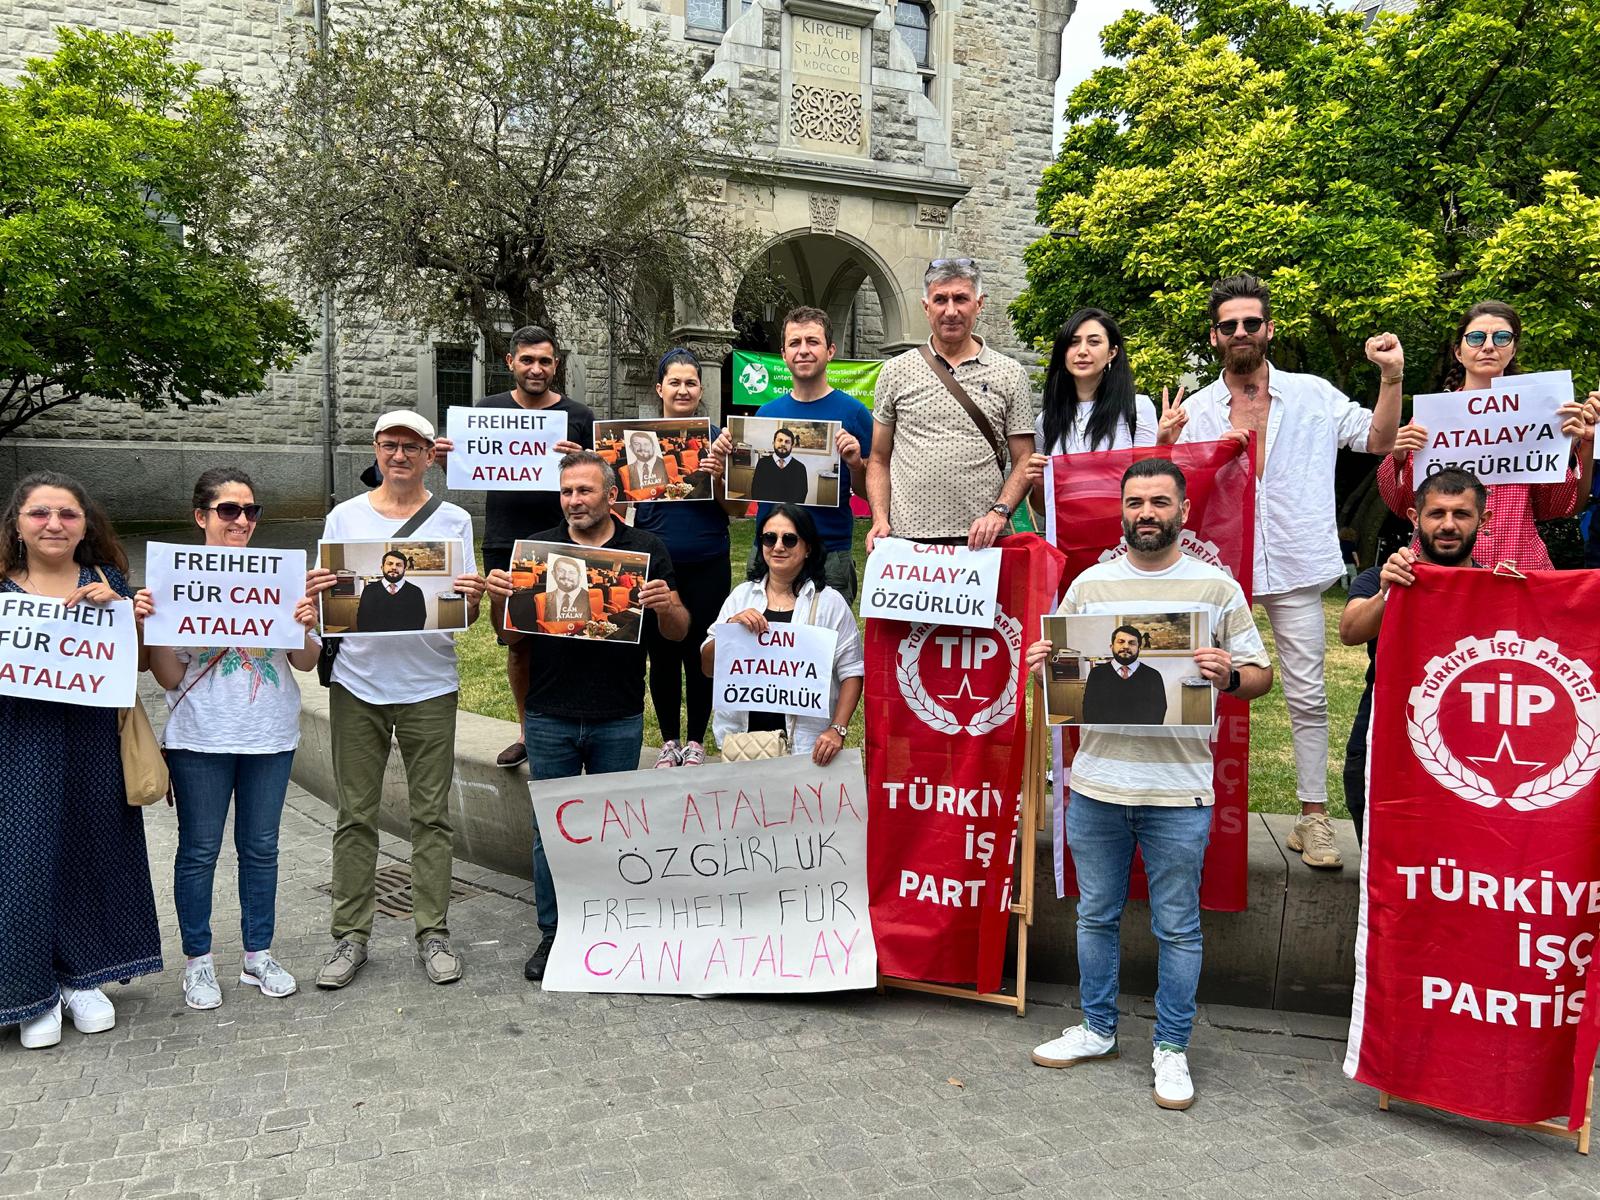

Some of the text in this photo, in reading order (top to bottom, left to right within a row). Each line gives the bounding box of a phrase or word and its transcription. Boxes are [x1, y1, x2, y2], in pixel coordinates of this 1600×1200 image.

[802, 19, 853, 40] KIRCHE
[822, 37, 834, 45] ZU
[803, 59, 850, 75] MDCCCCI
[1467, 393, 1519, 415] CAN
[467, 415, 547, 430] FREIHEIT
[467, 436, 547, 456] FÜR CAN
[472, 466, 543, 481] ATALAY
[174, 552, 283, 574] FREIHEIT
[913, 543, 956, 556] CAN
[173, 580, 281, 605] FÜR CAN
[871, 588, 985, 616] ÖZGÜRLÜK
[2, 599, 116, 627] FREIHEIT
[178, 616, 275, 637] ATALAY
[0, 626, 51, 653] FÜR
[59, 637, 115, 661] CAN
[757, 630, 795, 648] CAN
[935, 628, 999, 670] TİP
[0, 662, 106, 694] ATALAY
[1422, 639, 1597, 703] TÜRKİYE İŞÇİ PARTİSİ
[723, 683, 822, 710] ÖZGÜRLÜK
[1460, 672, 1556, 727] TİP
[555, 782, 863, 844] CAN ATALAYA
[617, 830, 847, 885] ÖZGÜRLÜK
[581, 880, 857, 935] FREIHEIT FÜR
[583, 927, 861, 982] CAN ATALAY
[1518, 922, 1600, 981] İŞÇ
[1421, 974, 1587, 1029] PARTİS
